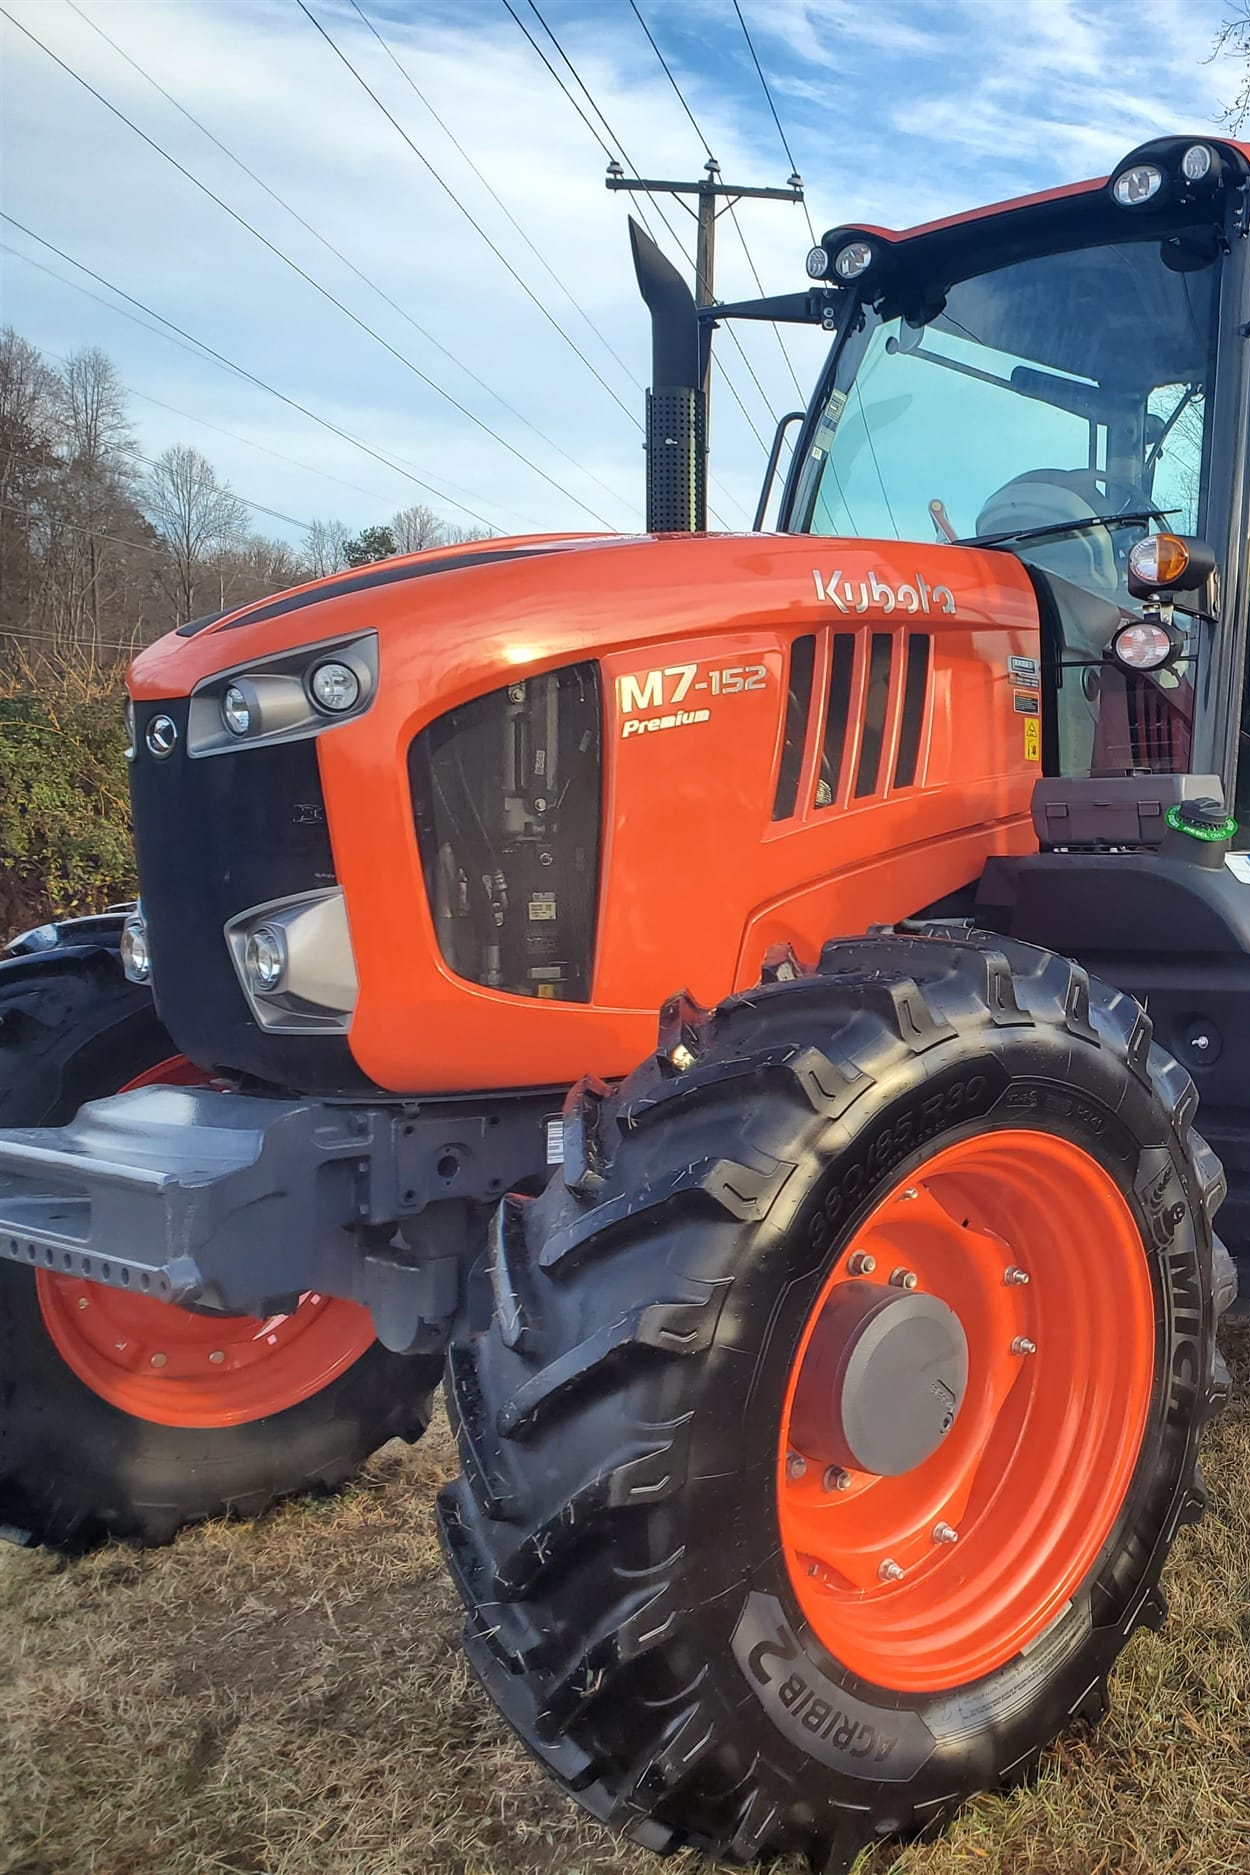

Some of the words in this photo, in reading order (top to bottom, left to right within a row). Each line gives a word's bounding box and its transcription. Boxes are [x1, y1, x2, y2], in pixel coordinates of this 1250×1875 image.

[812, 569, 957, 614] Kubota
[619, 663, 767, 714] M7-152
[621, 708, 711, 739] Premium
[748, 1624, 799, 1686] 2
[779, 1672, 899, 1763] AGRIBIB
